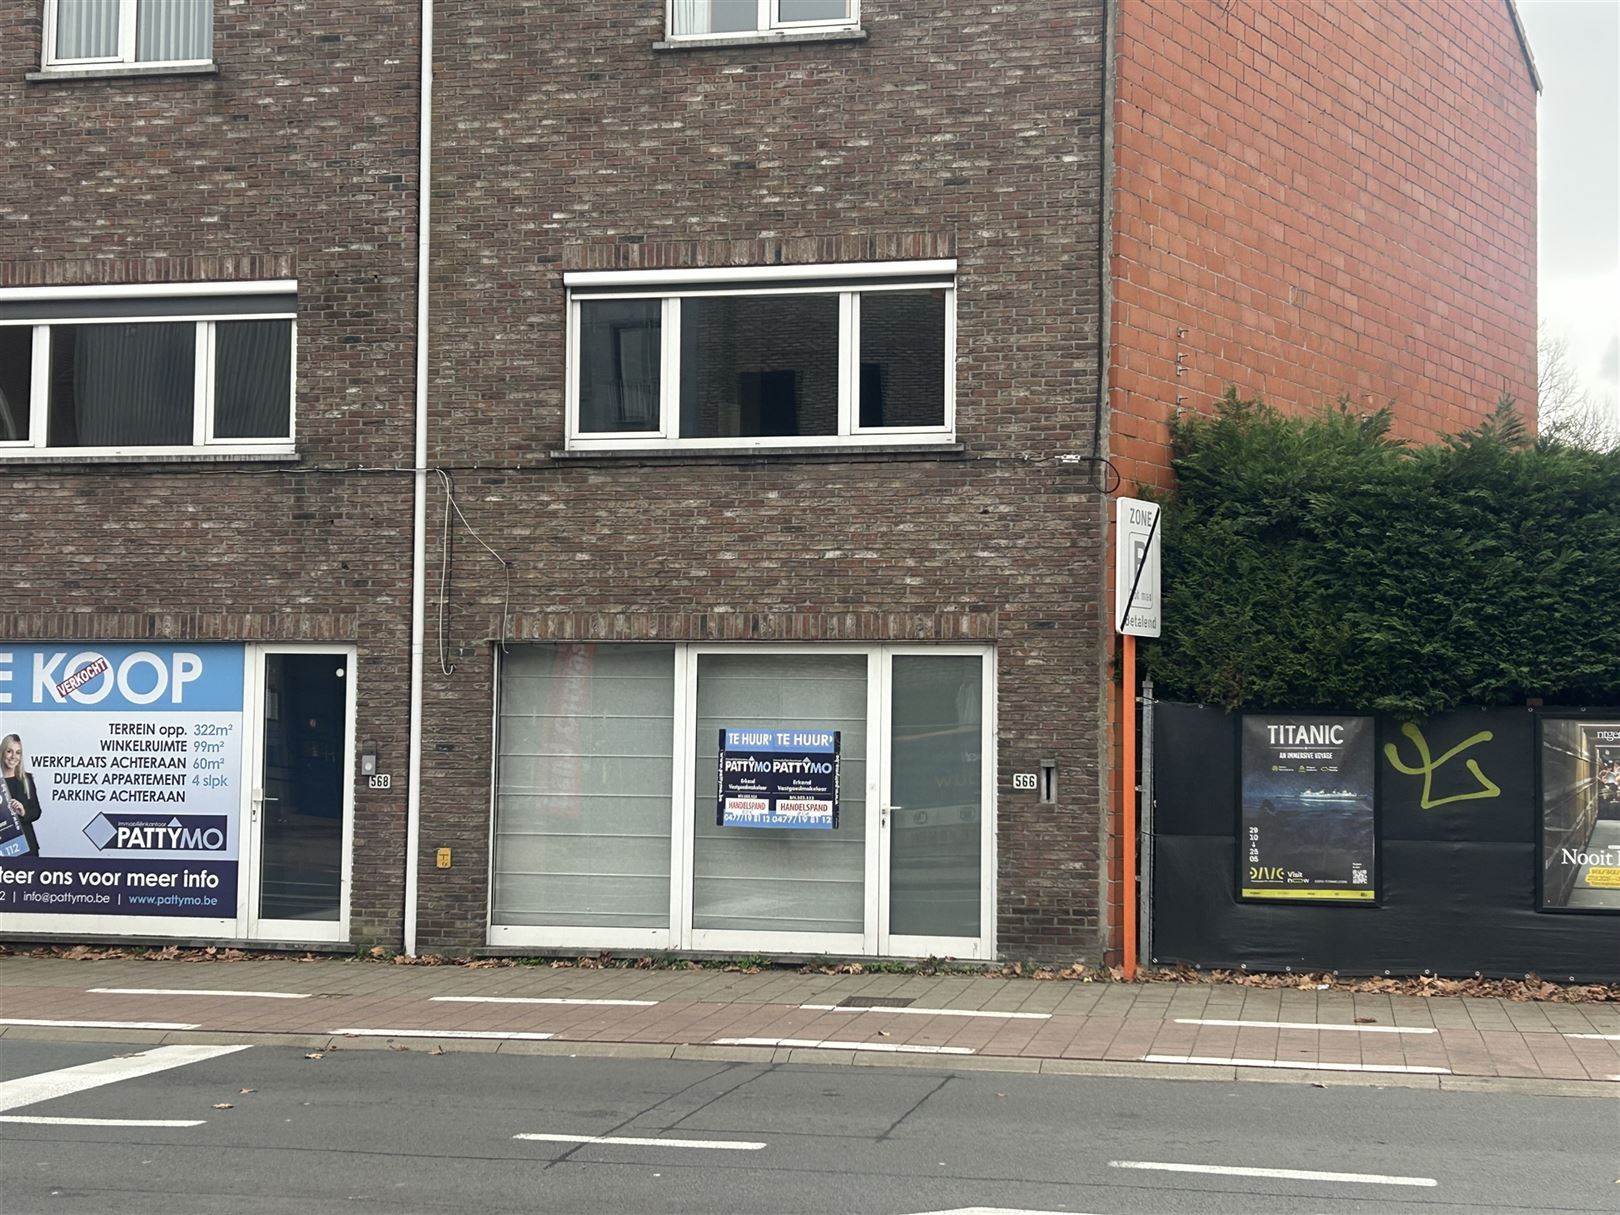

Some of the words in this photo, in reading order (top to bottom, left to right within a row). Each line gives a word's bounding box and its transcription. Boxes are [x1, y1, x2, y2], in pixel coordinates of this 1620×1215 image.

[1130, 508, 1152, 527] ZONE
[32, 652, 203, 704] KOOP
[57, 659, 107, 696] VERKOCHT
[109, 723, 155, 736] TERREIN
[159, 726, 187, 738] opp.
[193, 724, 233, 736] 322m²
[1267, 725, 1344, 744] TITANIC
[728, 733, 739, 744] TE
[776, 733, 789, 745] TE
[100, 740, 187, 752] WINKELRUIMTE
[193, 741, 224, 753] 99m²
[31, 756, 107, 768] WERKPLAATS
[110, 757, 187, 769] ACHTERAAN
[192, 757, 224, 770] 60m²
[725, 761, 771, 773] PATTYMO
[773, 762, 832, 774] PATTYMO
[54, 773, 98, 785] DUPLEX
[101, 773, 187, 786] APPARTEMENT
[192, 775, 200, 786] 4
[202, 774, 228, 789] slpk
[371, 776, 389, 787] 568
[1015, 775, 1035, 787] 566
[52, 789, 106, 802] PARKING
[109, 790, 186, 803] ACHTERAAN
[728, 801, 766, 810] HANDELSPAND
[781, 802, 828, 812] HANDELSPAND
[822, 816, 831, 824] 12
[117, 827, 224, 849] PATTYMO
[1561, 848, 1613, 866] Nooit
[40, 870, 73, 885] ons
[78, 872, 121, 886] voor
[127, 872, 178, 887] meer
[184, 869, 219, 888] info
[24, 890, 110, 905] info@pattymo.be
[129, 894, 218, 907] www.pattymo.be
